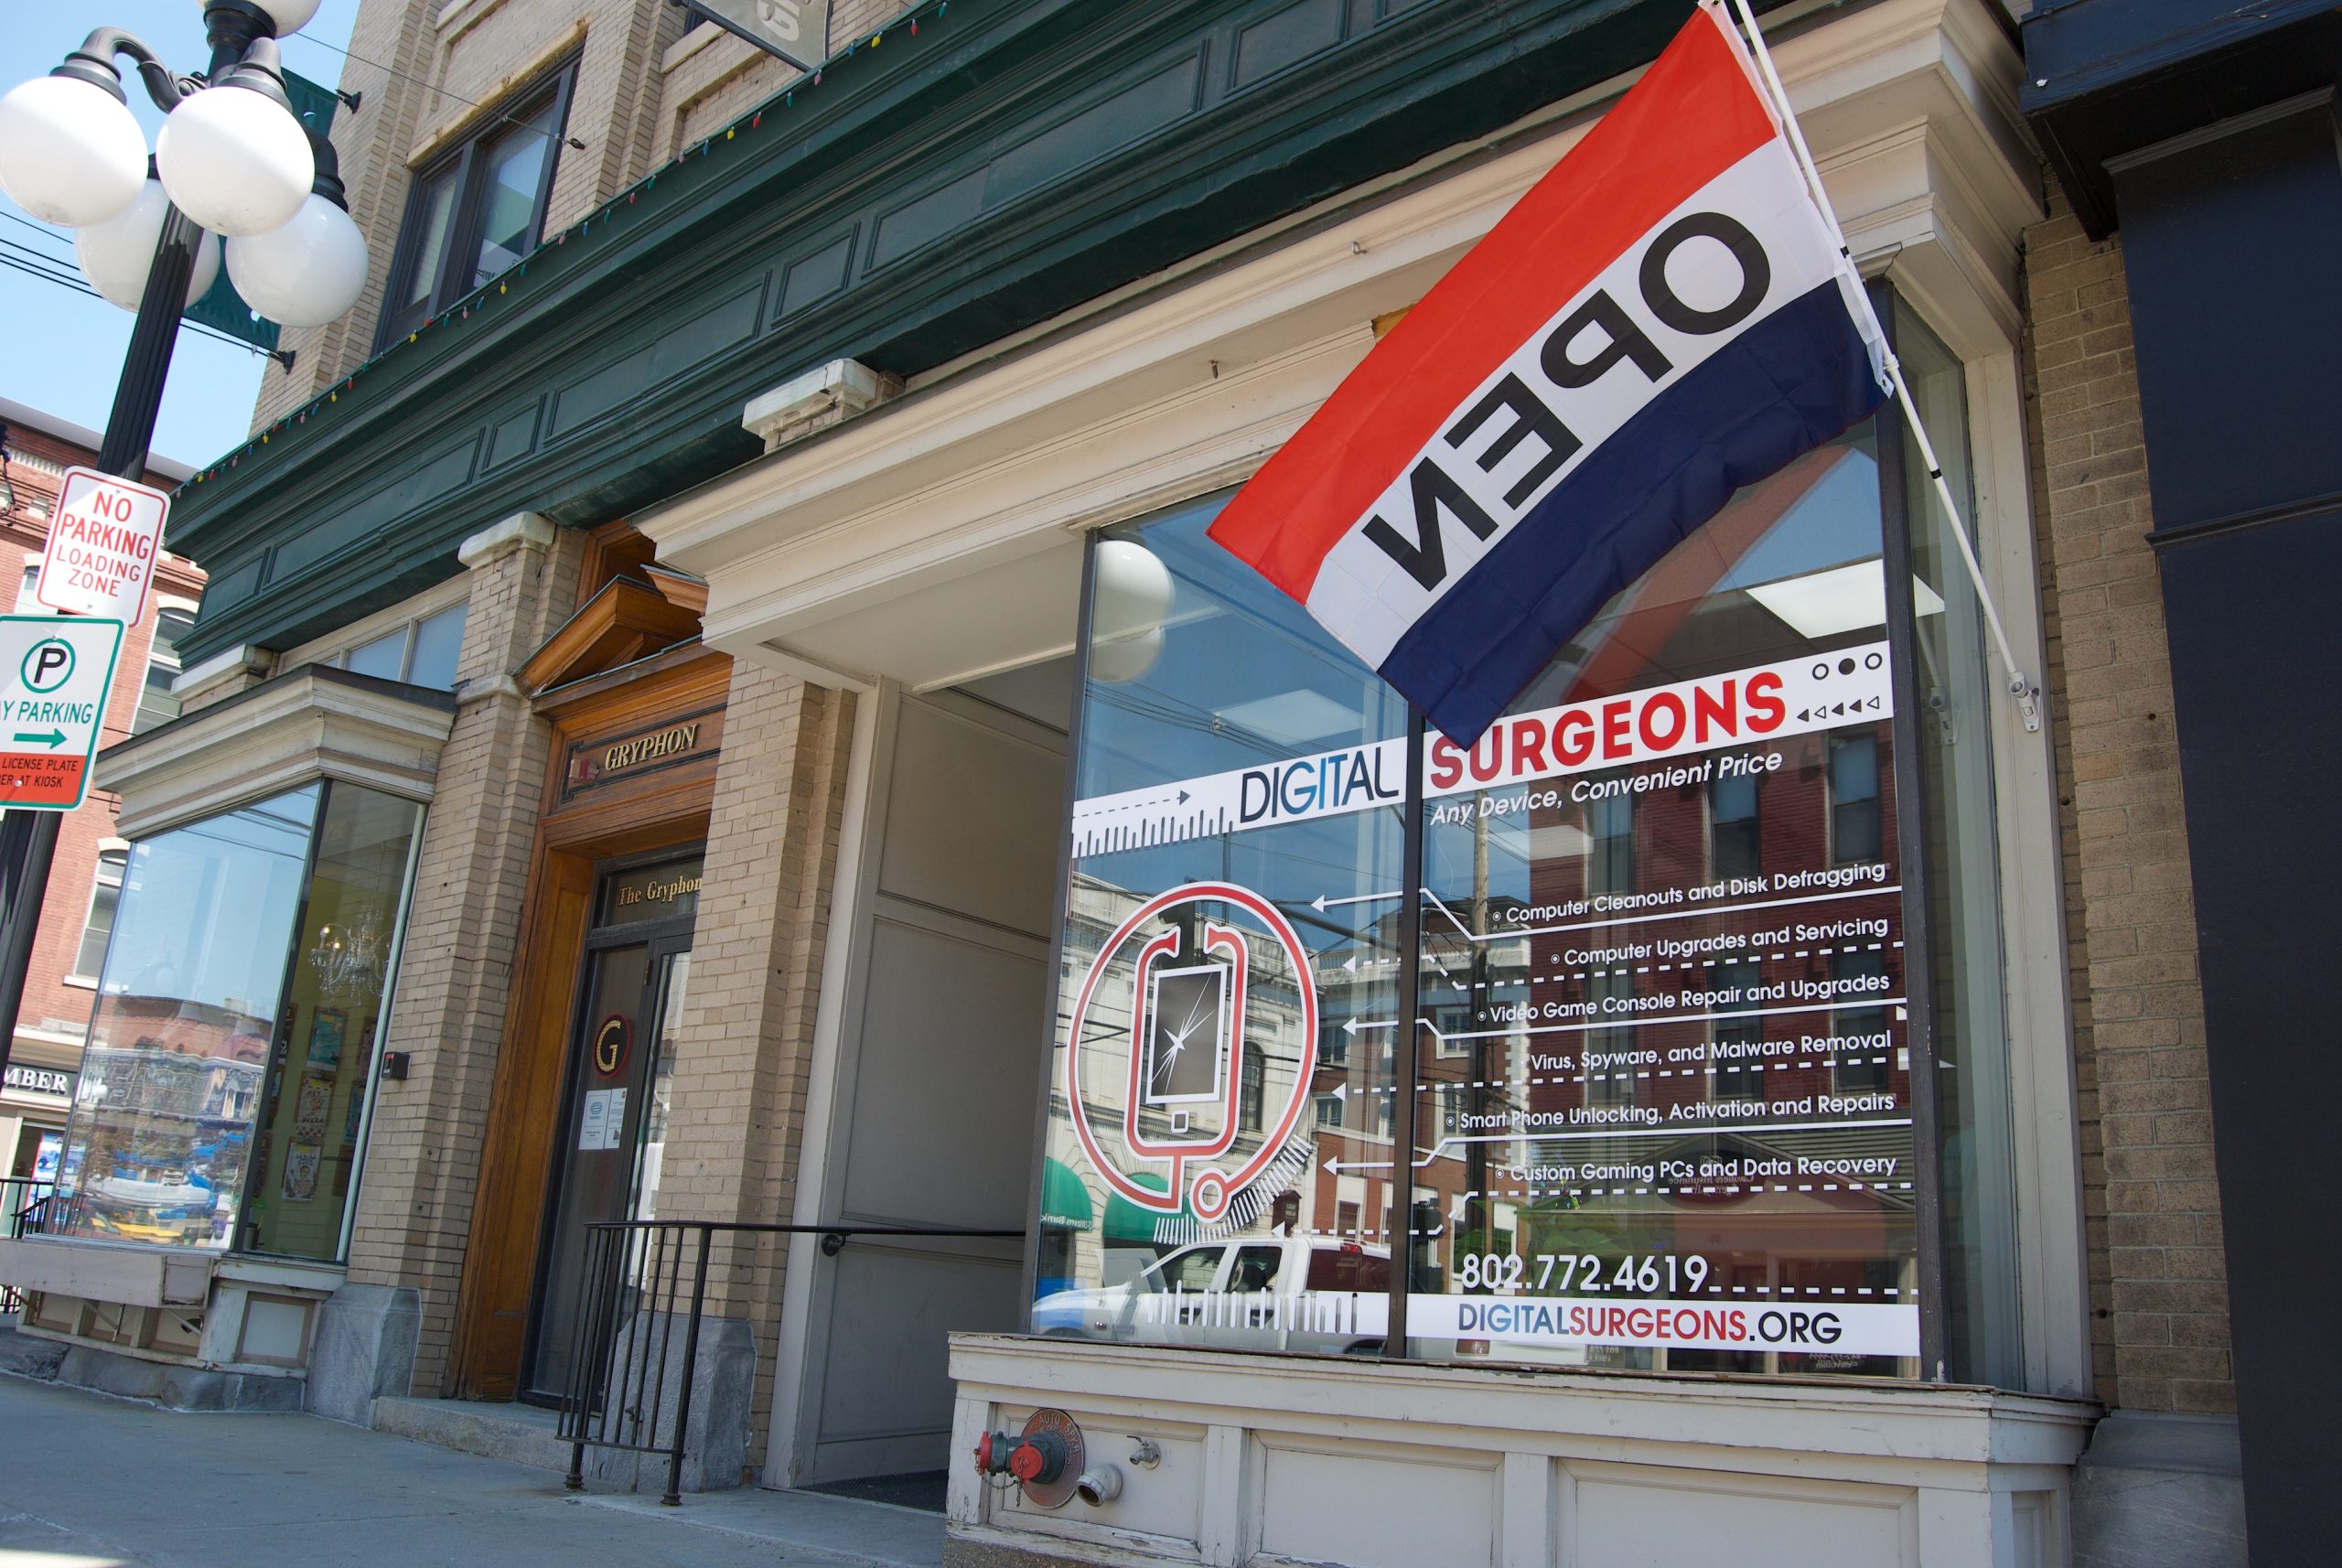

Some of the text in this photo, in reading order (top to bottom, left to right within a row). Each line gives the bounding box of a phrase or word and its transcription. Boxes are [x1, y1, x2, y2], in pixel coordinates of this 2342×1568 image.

[93, 491, 132, 522] NO
[59, 513, 151, 559] PARKING
[57, 544, 141, 582] LOADING
[68, 568, 121, 597] ZONE
[34, 648, 67, 683] P
[0, 700, 93, 725] Y PARKING
[1430, 671, 1787, 789] SURGEONS
[2, 757, 78, 772] LICENSE PLATE
[605, 724, 698, 771] GRYPHON
[34, 776, 64, 788] KIOSK
[1240, 746, 1399, 823] DIGITAL
[1430, 749, 1783, 826] Any Device, Convenient Price
[617, 875, 703, 907] The Gryphon
[1506, 864, 1885, 923] Computer Cleanouts and Disk Defragging
[1564, 918, 1888, 965] Computer Upgrades and Servicing
[1489, 974, 1890, 1023] Video Game Console Repair and Upgrades
[596, 1020, 621, 1072] G
[1531, 1029, 1892, 1071] Virus, Spyware, and Malware Removal
[1460, 1092, 1896, 1130] Smart Phone Unlocking, Activation and Repairs
[1510, 1164, 1576, 1182] Custom
[1581, 1161, 1655, 1183] Gaming
[1660, 1159, 1695, 1179] PCs
[1699, 1158, 1738, 1178] and
[1744, 1157, 1791, 1176] Data
[1797, 1155, 1897, 1177] Recovery
[1462, 1253, 1709, 1294] 802.772.4619
[1457, 1303, 1842, 1344] DIGITALSURGEONS.ORG
